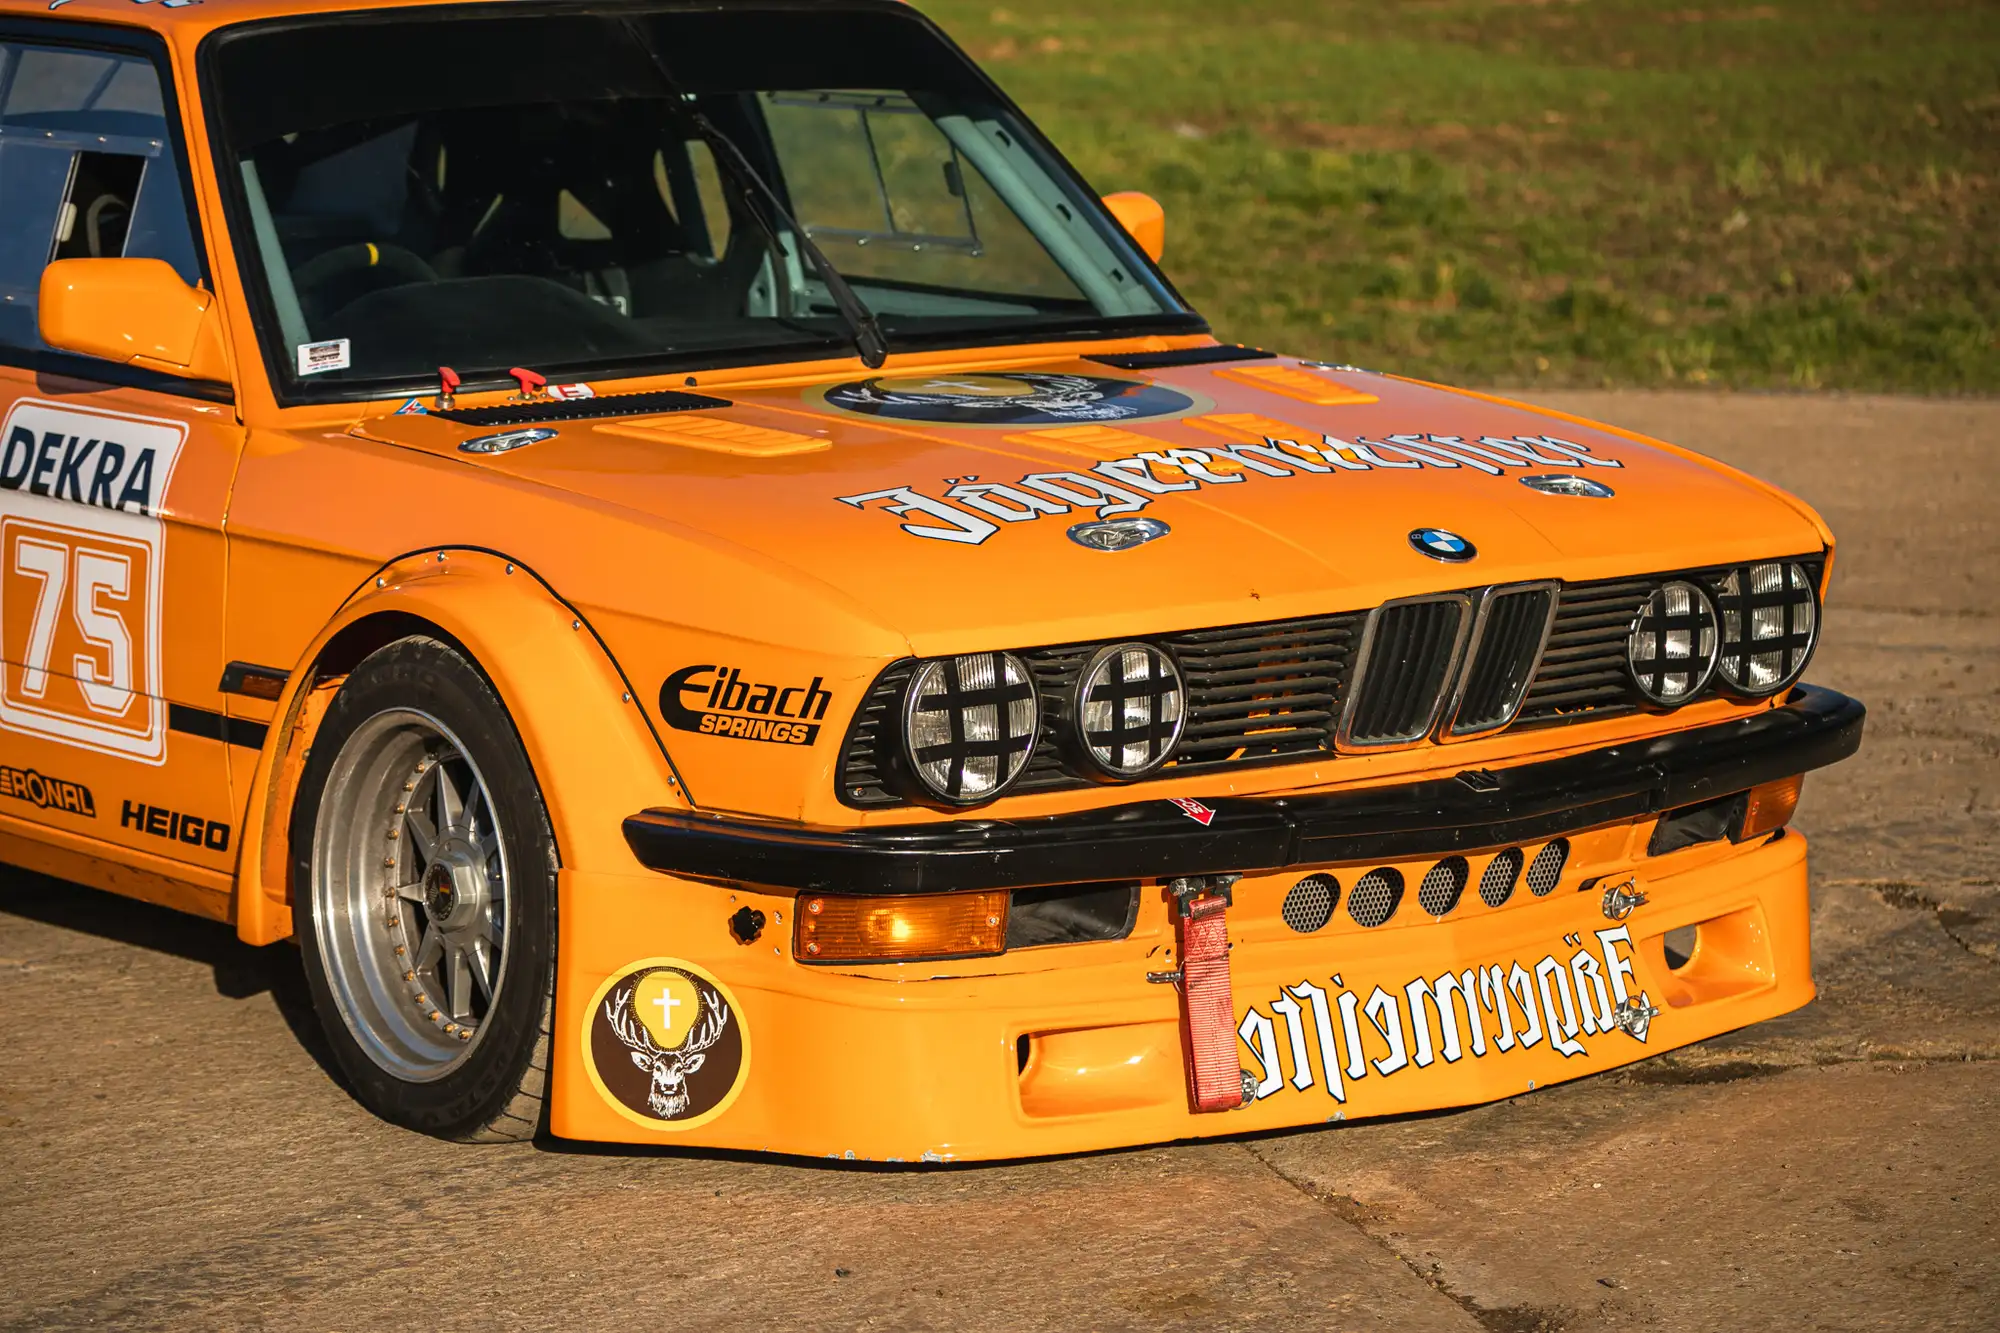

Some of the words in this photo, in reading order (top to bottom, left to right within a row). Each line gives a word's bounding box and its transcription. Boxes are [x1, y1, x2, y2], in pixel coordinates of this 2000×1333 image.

[0, 425, 156, 517] DEKRA
[834, 432, 1625, 546] Jägermeister
[14, 535, 136, 718] 75
[659, 665, 833, 728] Eibach
[699, 714, 809, 744] SPRINGS
[11, 768, 95, 816] RONAL
[121, 800, 230, 852] HEIGO
